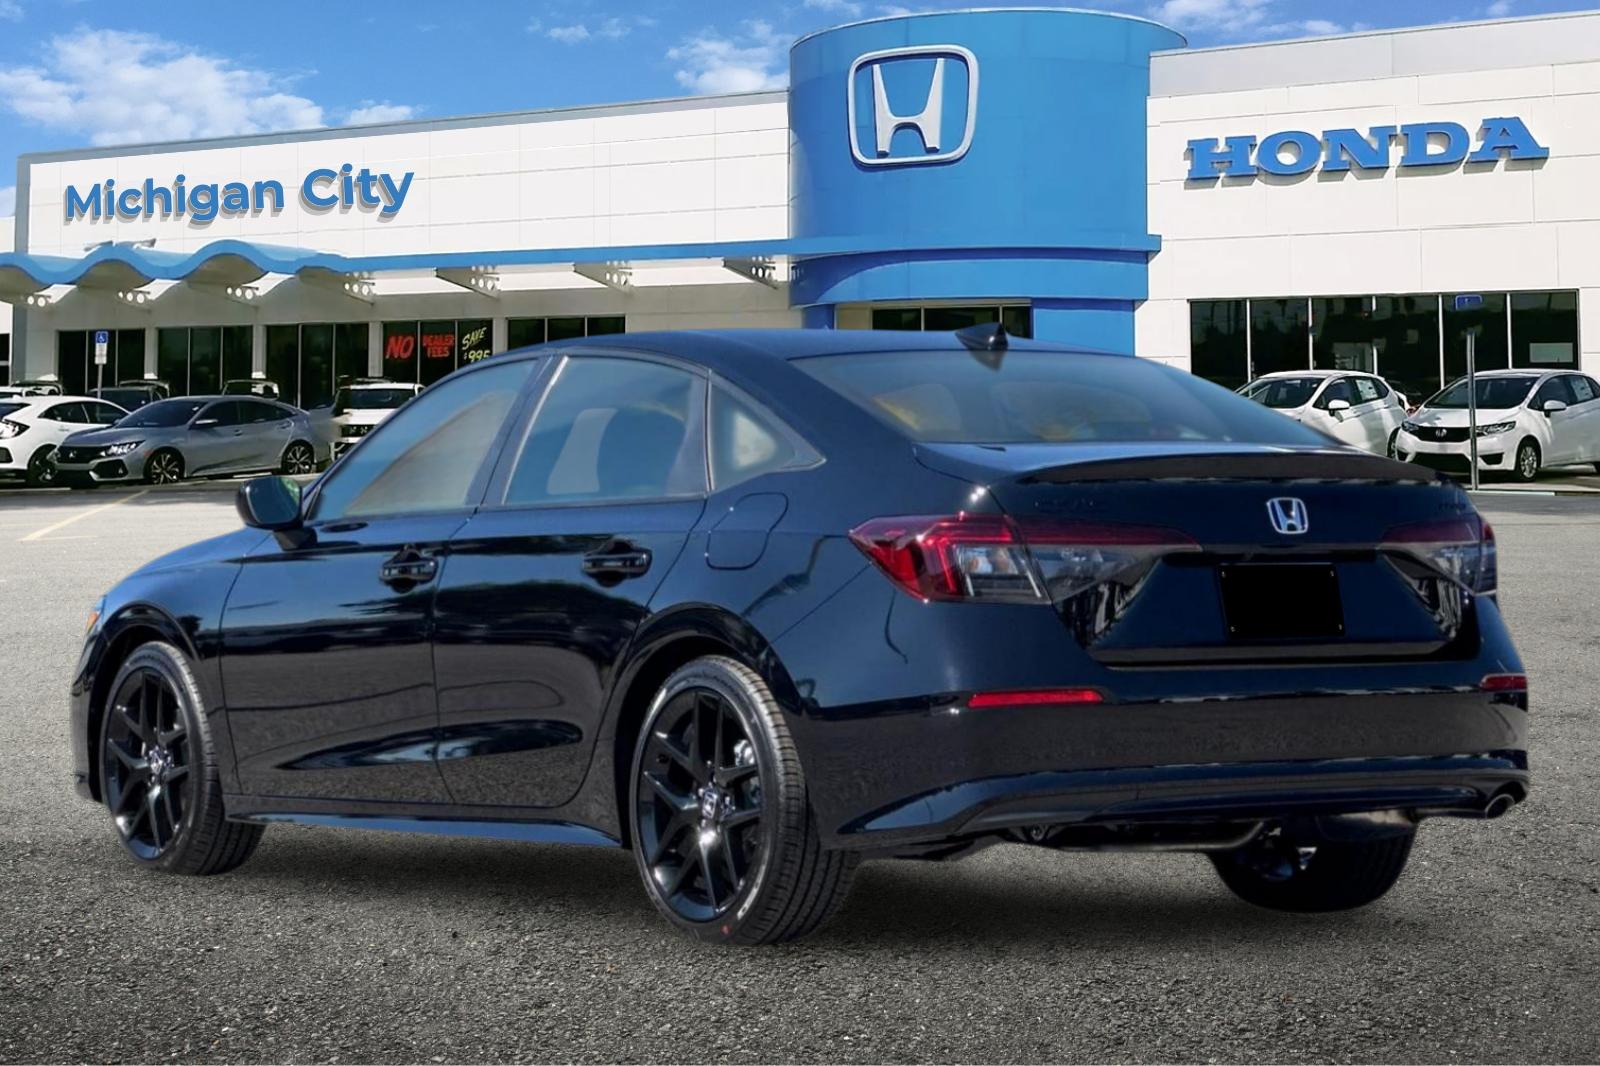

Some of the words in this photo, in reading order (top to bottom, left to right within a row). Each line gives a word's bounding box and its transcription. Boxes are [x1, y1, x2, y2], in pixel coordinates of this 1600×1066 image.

[1185, 116, 1550, 184] HONDA
[66, 173, 285, 224] Michigan
[301, 162, 415, 217] City
[385, 334, 416, 359] NO
[461, 326, 487, 351] SAVE
